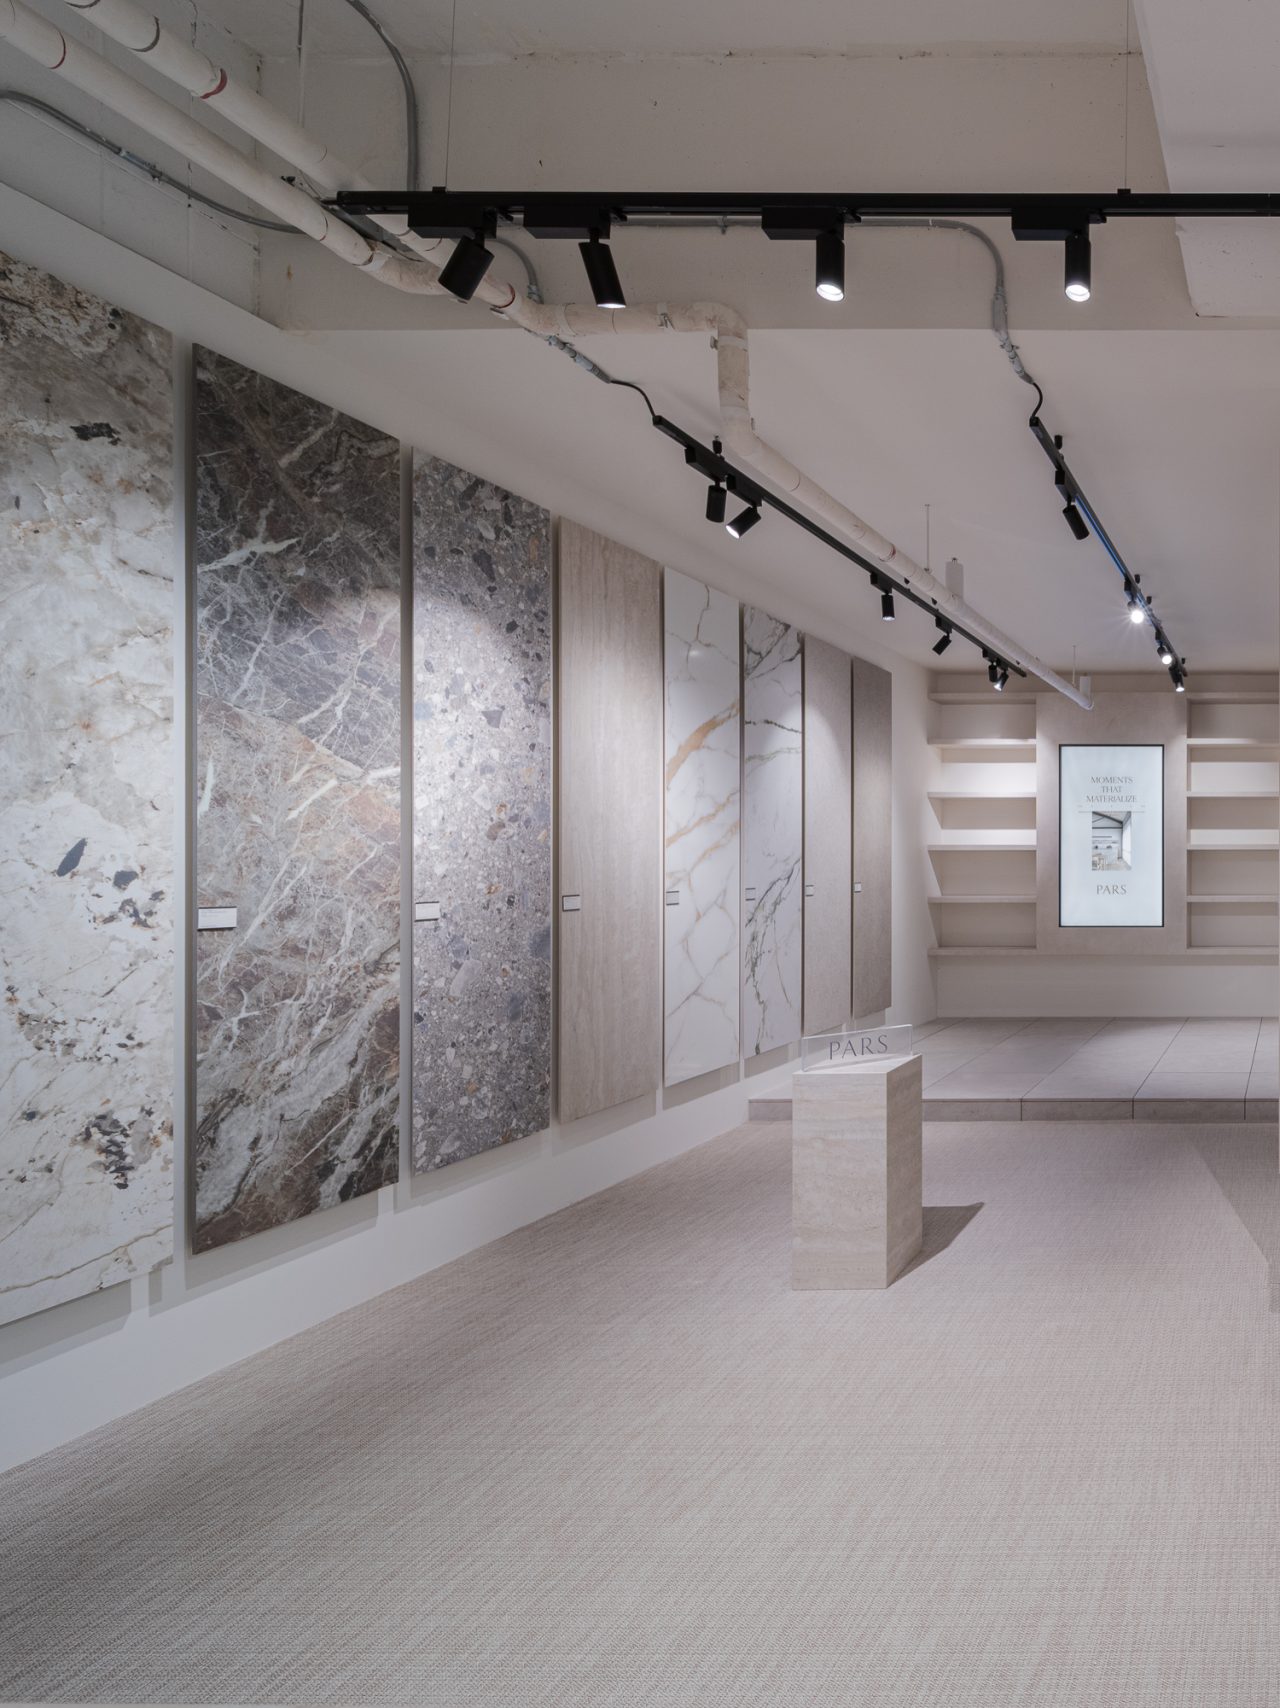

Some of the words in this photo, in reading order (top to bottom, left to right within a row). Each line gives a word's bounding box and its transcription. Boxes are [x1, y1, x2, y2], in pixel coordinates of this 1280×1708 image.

[1090, 776, 1134, 784] MOMENTS
[1085, 795, 1137, 803] MATERIALIZE
[1096, 884, 1127, 895] PARS
[829, 1034, 888, 1060] PARS
